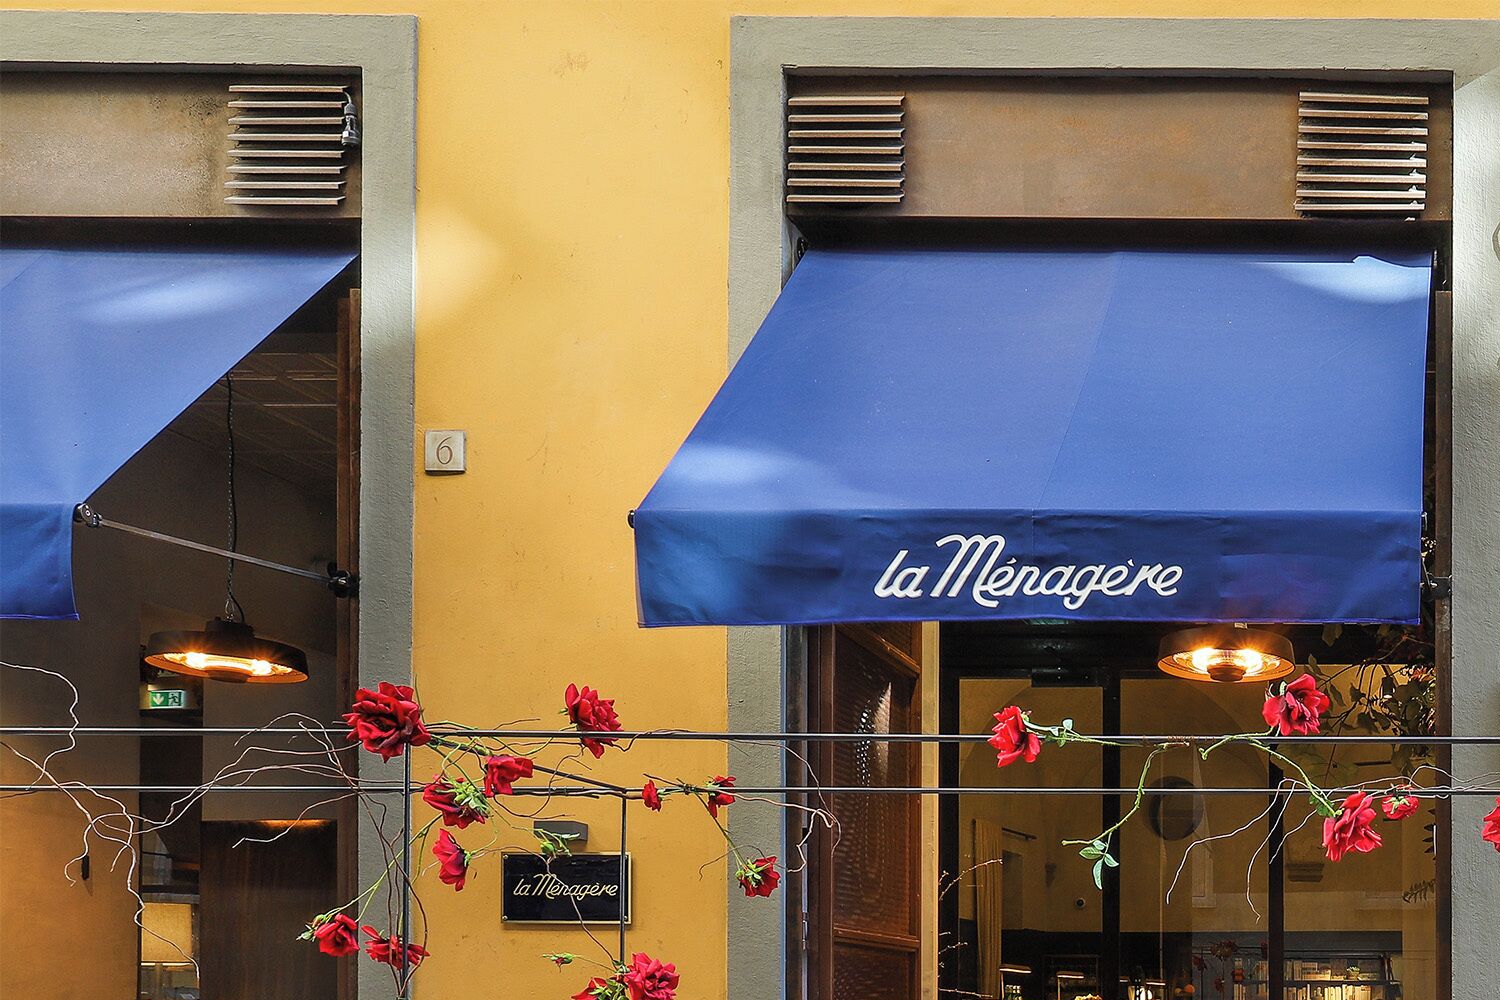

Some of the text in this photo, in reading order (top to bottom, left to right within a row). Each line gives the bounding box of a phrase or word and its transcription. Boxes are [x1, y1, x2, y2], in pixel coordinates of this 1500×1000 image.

[435, 436, 454, 465] 6
[873, 534, 1184, 610] la Ménagère
[512, 873, 619, 901] la Ménagère
